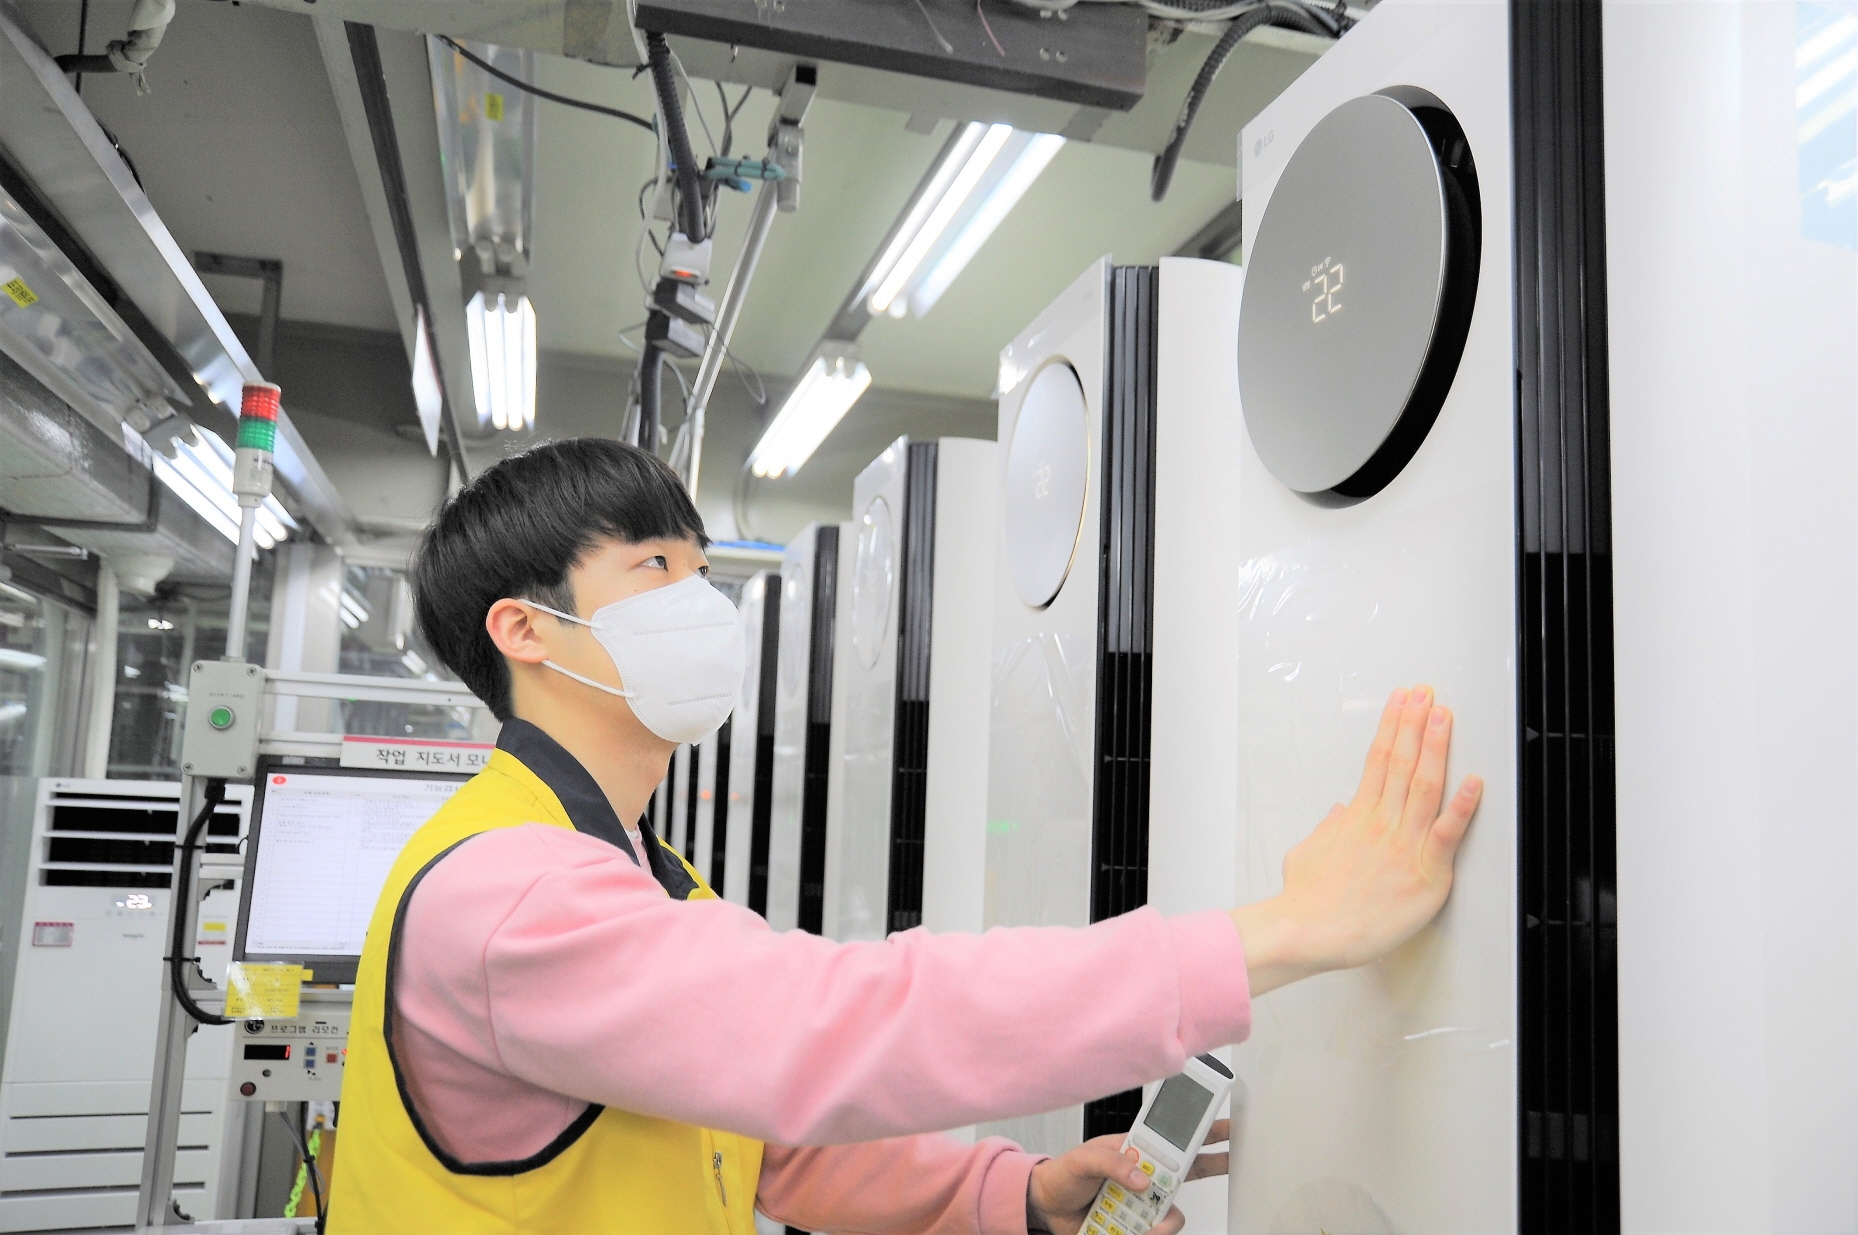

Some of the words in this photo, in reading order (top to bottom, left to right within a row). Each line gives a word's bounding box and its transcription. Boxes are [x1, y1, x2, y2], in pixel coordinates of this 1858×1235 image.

[1263, 129, 1274, 148] LG
[1312, 263, 1344, 323] 22
[1035, 465, 1050, 499] 22
[376, 749, 406, 765] 작업
[415, 751, 460, 767] 지도서
[270, 1025, 306, 1034] 프로그램
